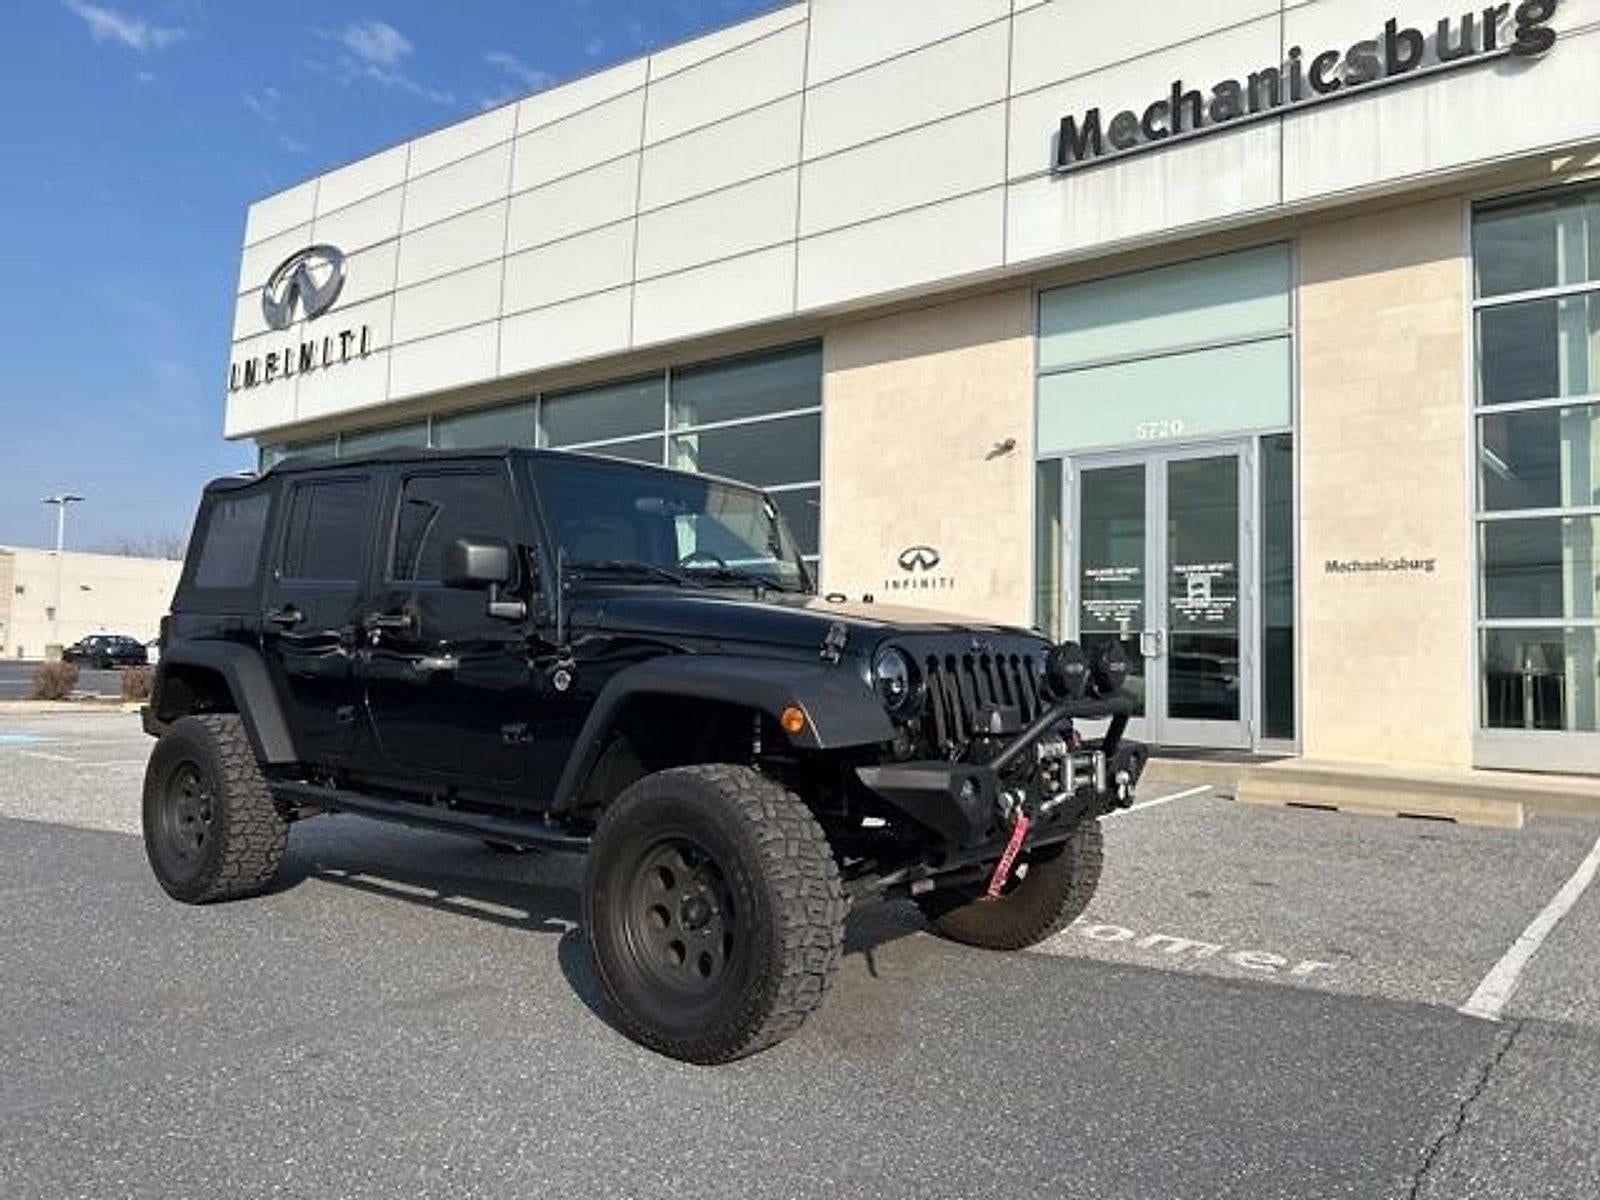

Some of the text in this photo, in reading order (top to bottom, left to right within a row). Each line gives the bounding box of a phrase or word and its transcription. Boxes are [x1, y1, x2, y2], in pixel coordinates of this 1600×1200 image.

[1056, 0, 1557, 166] Mechanicsburg
[229, 325, 372, 391] INFINITI
[885, 577, 955, 590] INFINITI
[1325, 557, 1436, 574] Mechanicsburg
